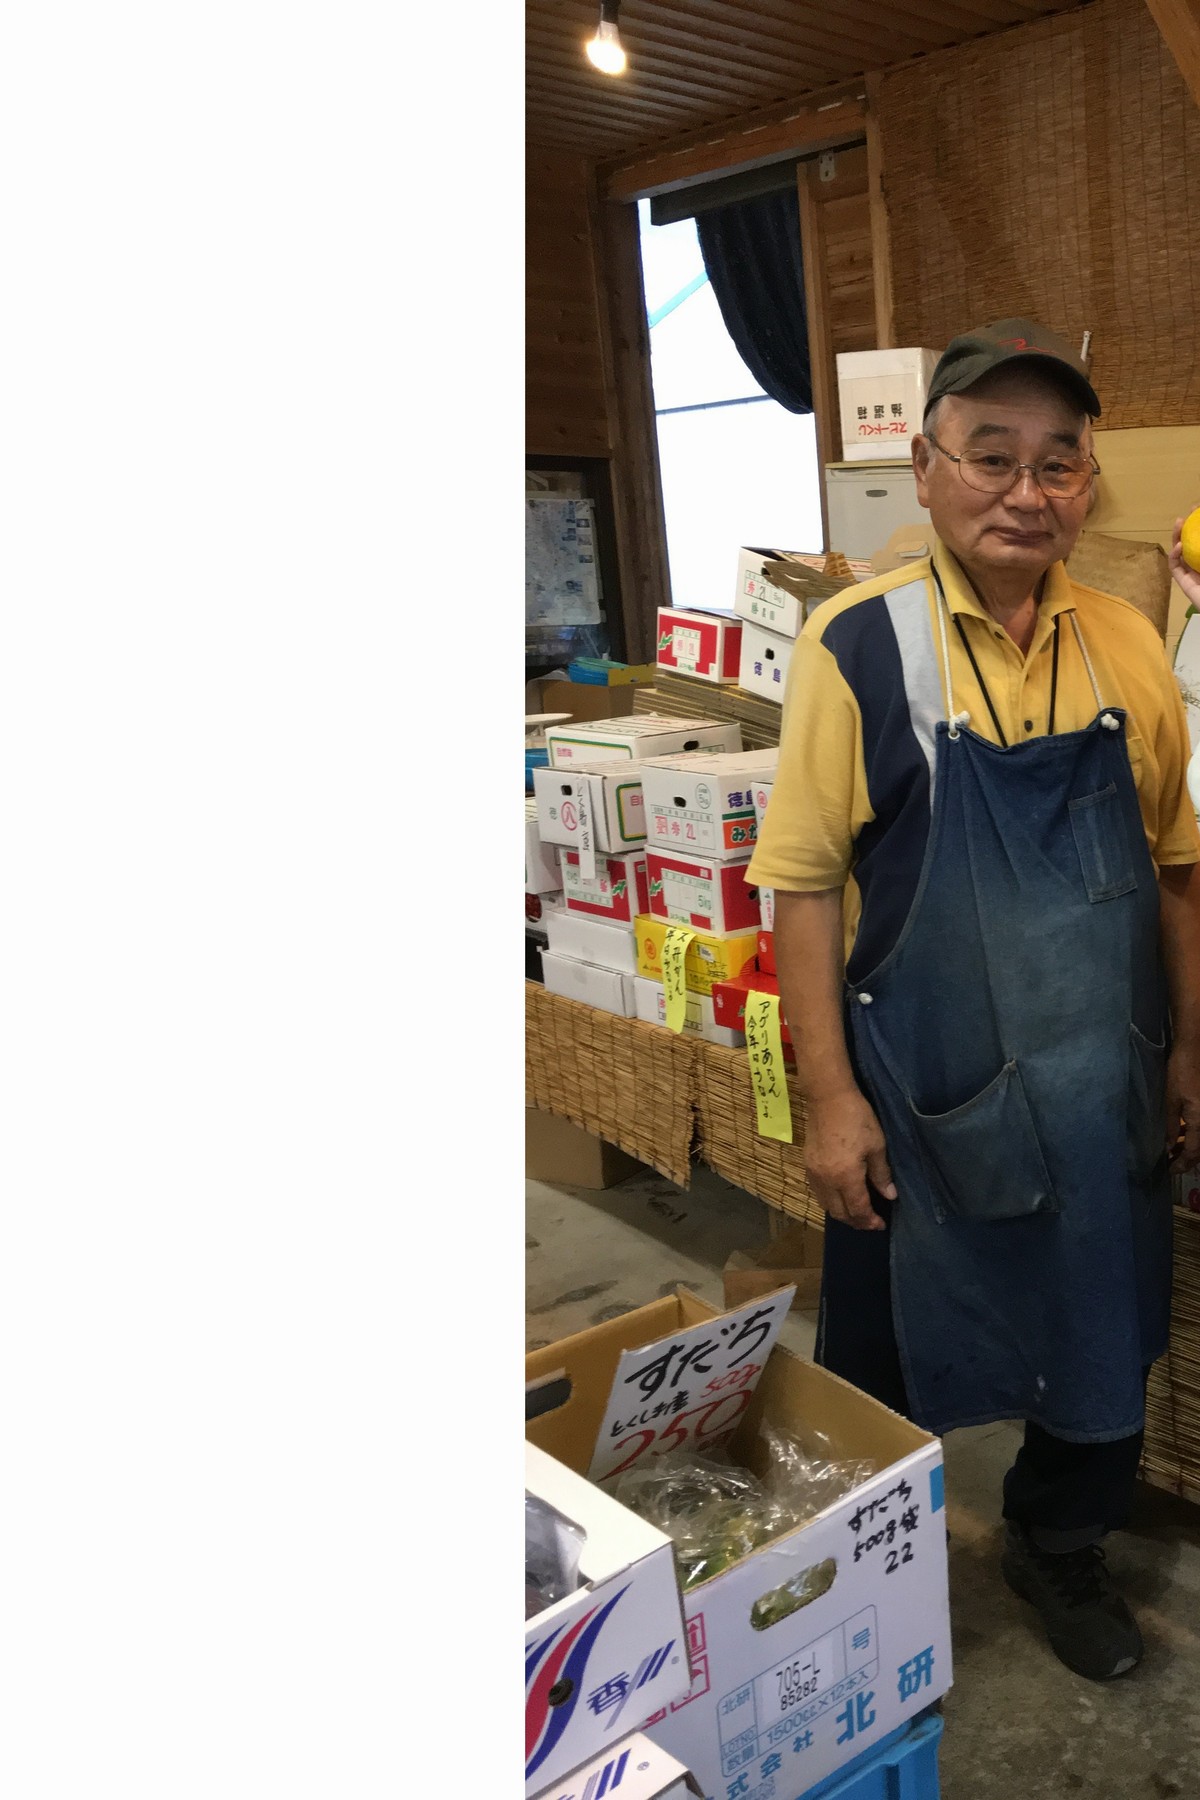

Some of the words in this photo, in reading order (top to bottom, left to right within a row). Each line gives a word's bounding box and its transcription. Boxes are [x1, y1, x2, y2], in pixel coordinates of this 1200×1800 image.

[759, 1000, 782, 1098] アグリあなん
[624, 1305, 775, 1402] すだち
[847, 1477, 912, 1535] すだち
[884, 1541, 914, 1575] 22
[851, 1627, 872, 1651] 号
[775, 1650, 821, 1697] 705-L
[780, 1676, 818, 1711] 85282
[705, 1729, 814, 1800] 式会社
[836, 1644, 937, 1746] 北研
[722, 1687, 752, 1716] 北研
